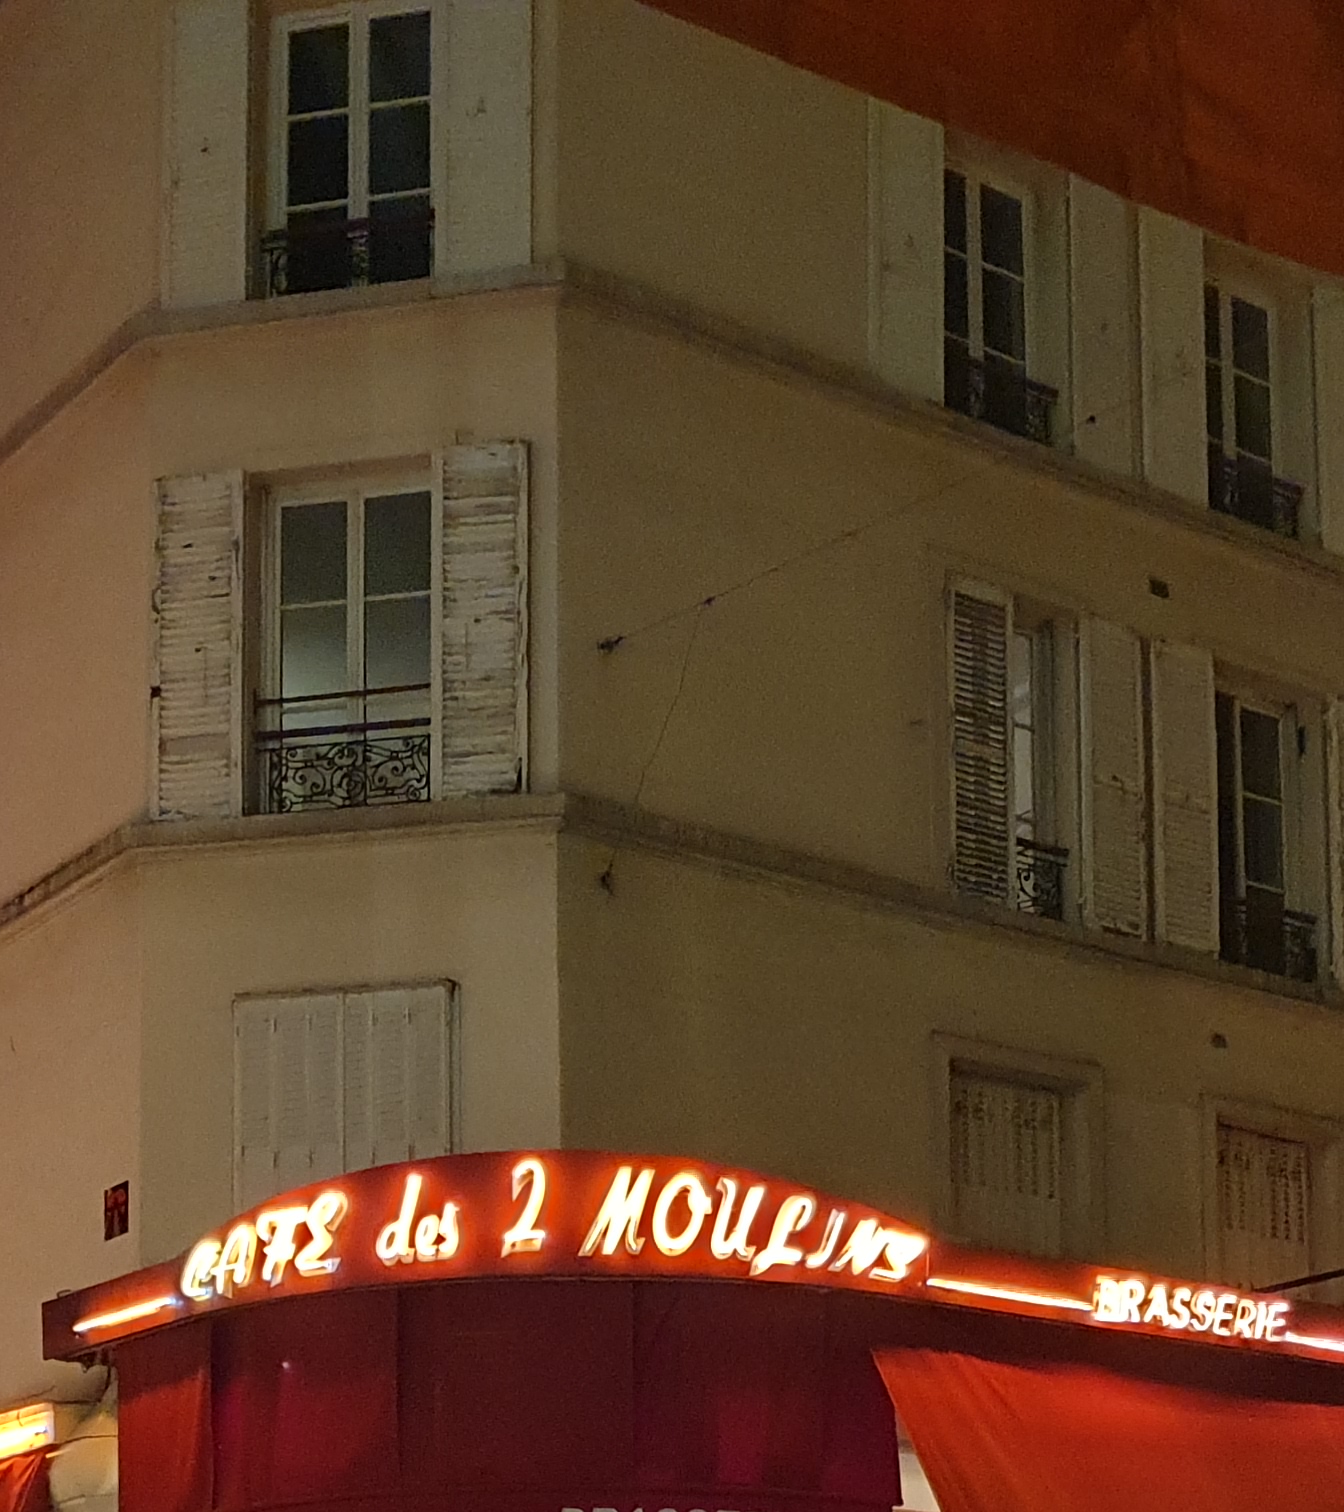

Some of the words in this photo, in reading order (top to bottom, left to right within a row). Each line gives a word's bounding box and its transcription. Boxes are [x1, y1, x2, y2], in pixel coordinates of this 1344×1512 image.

[376, 1173, 459, 1266] des
[501, 1159, 547, 1258] 2
[578, 1166, 929, 1282] MOULINS
[1094, 1275, 1289, 1342] BRASSERIE
